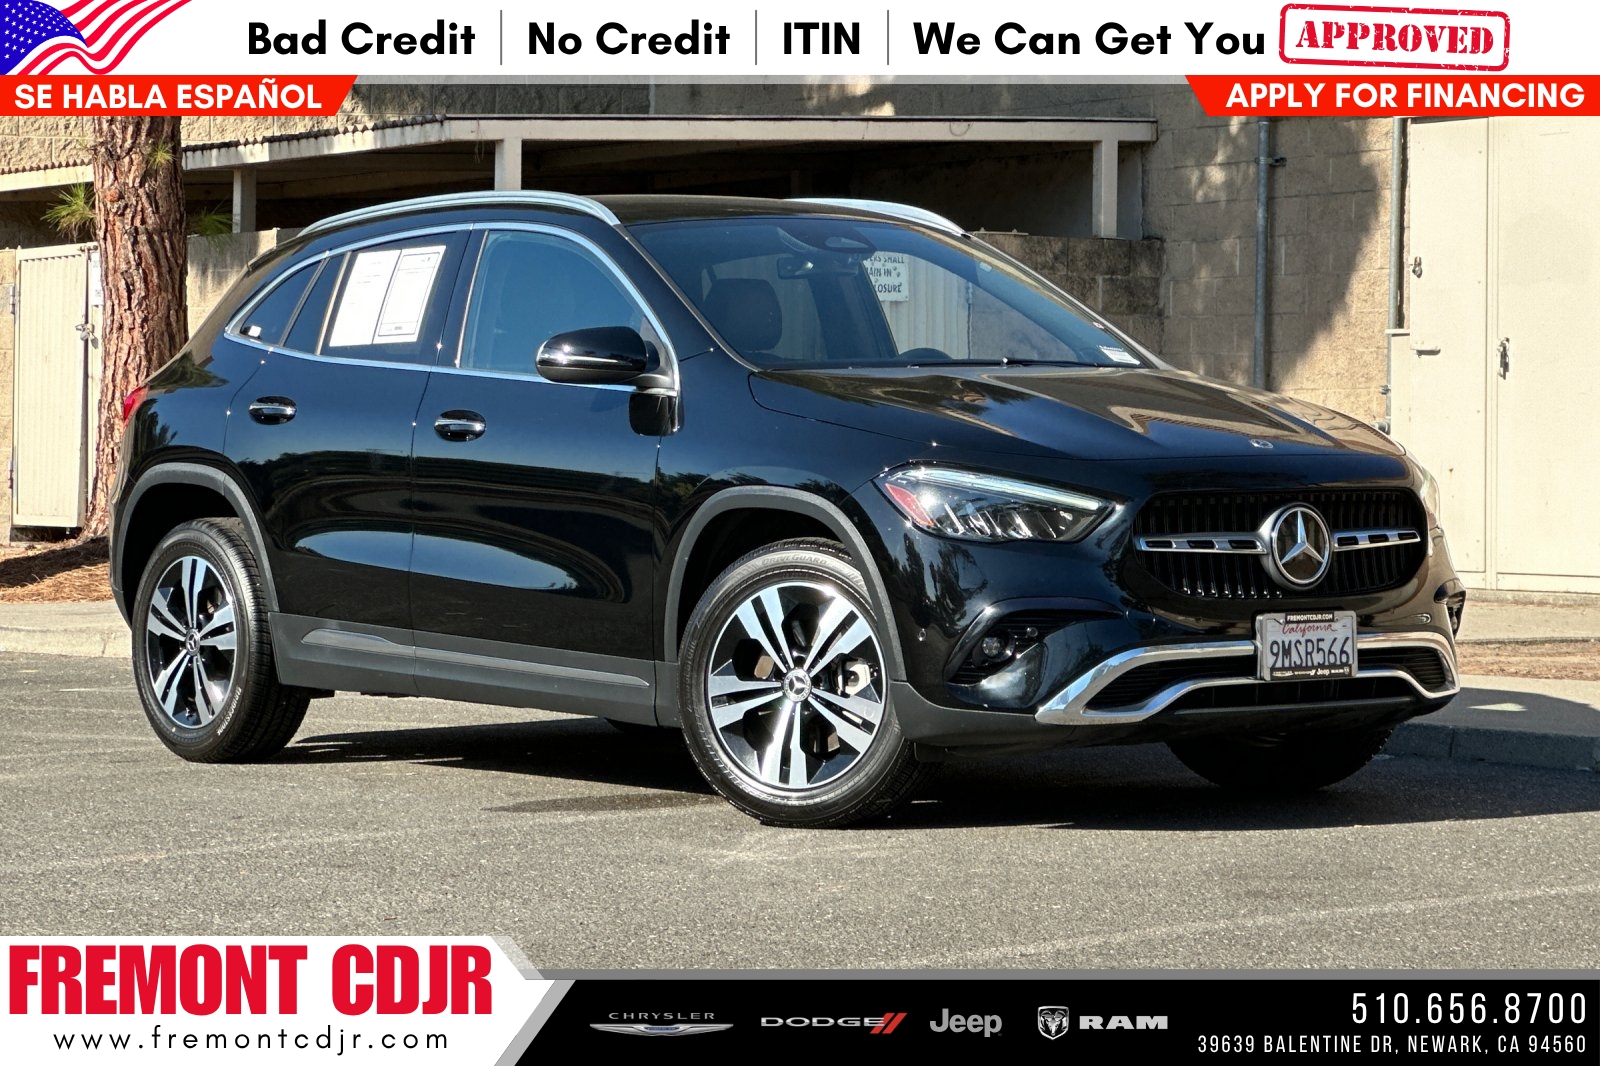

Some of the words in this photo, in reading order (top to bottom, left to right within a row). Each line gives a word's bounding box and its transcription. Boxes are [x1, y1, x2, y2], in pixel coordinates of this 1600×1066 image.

[883, 268, 892, 277] IN
[1286, 613, 1333, 621] FREMONTCDJR.COM
[1282, 623, 1338, 637] California
[1270, 637, 1350, 668] 9MSR566
